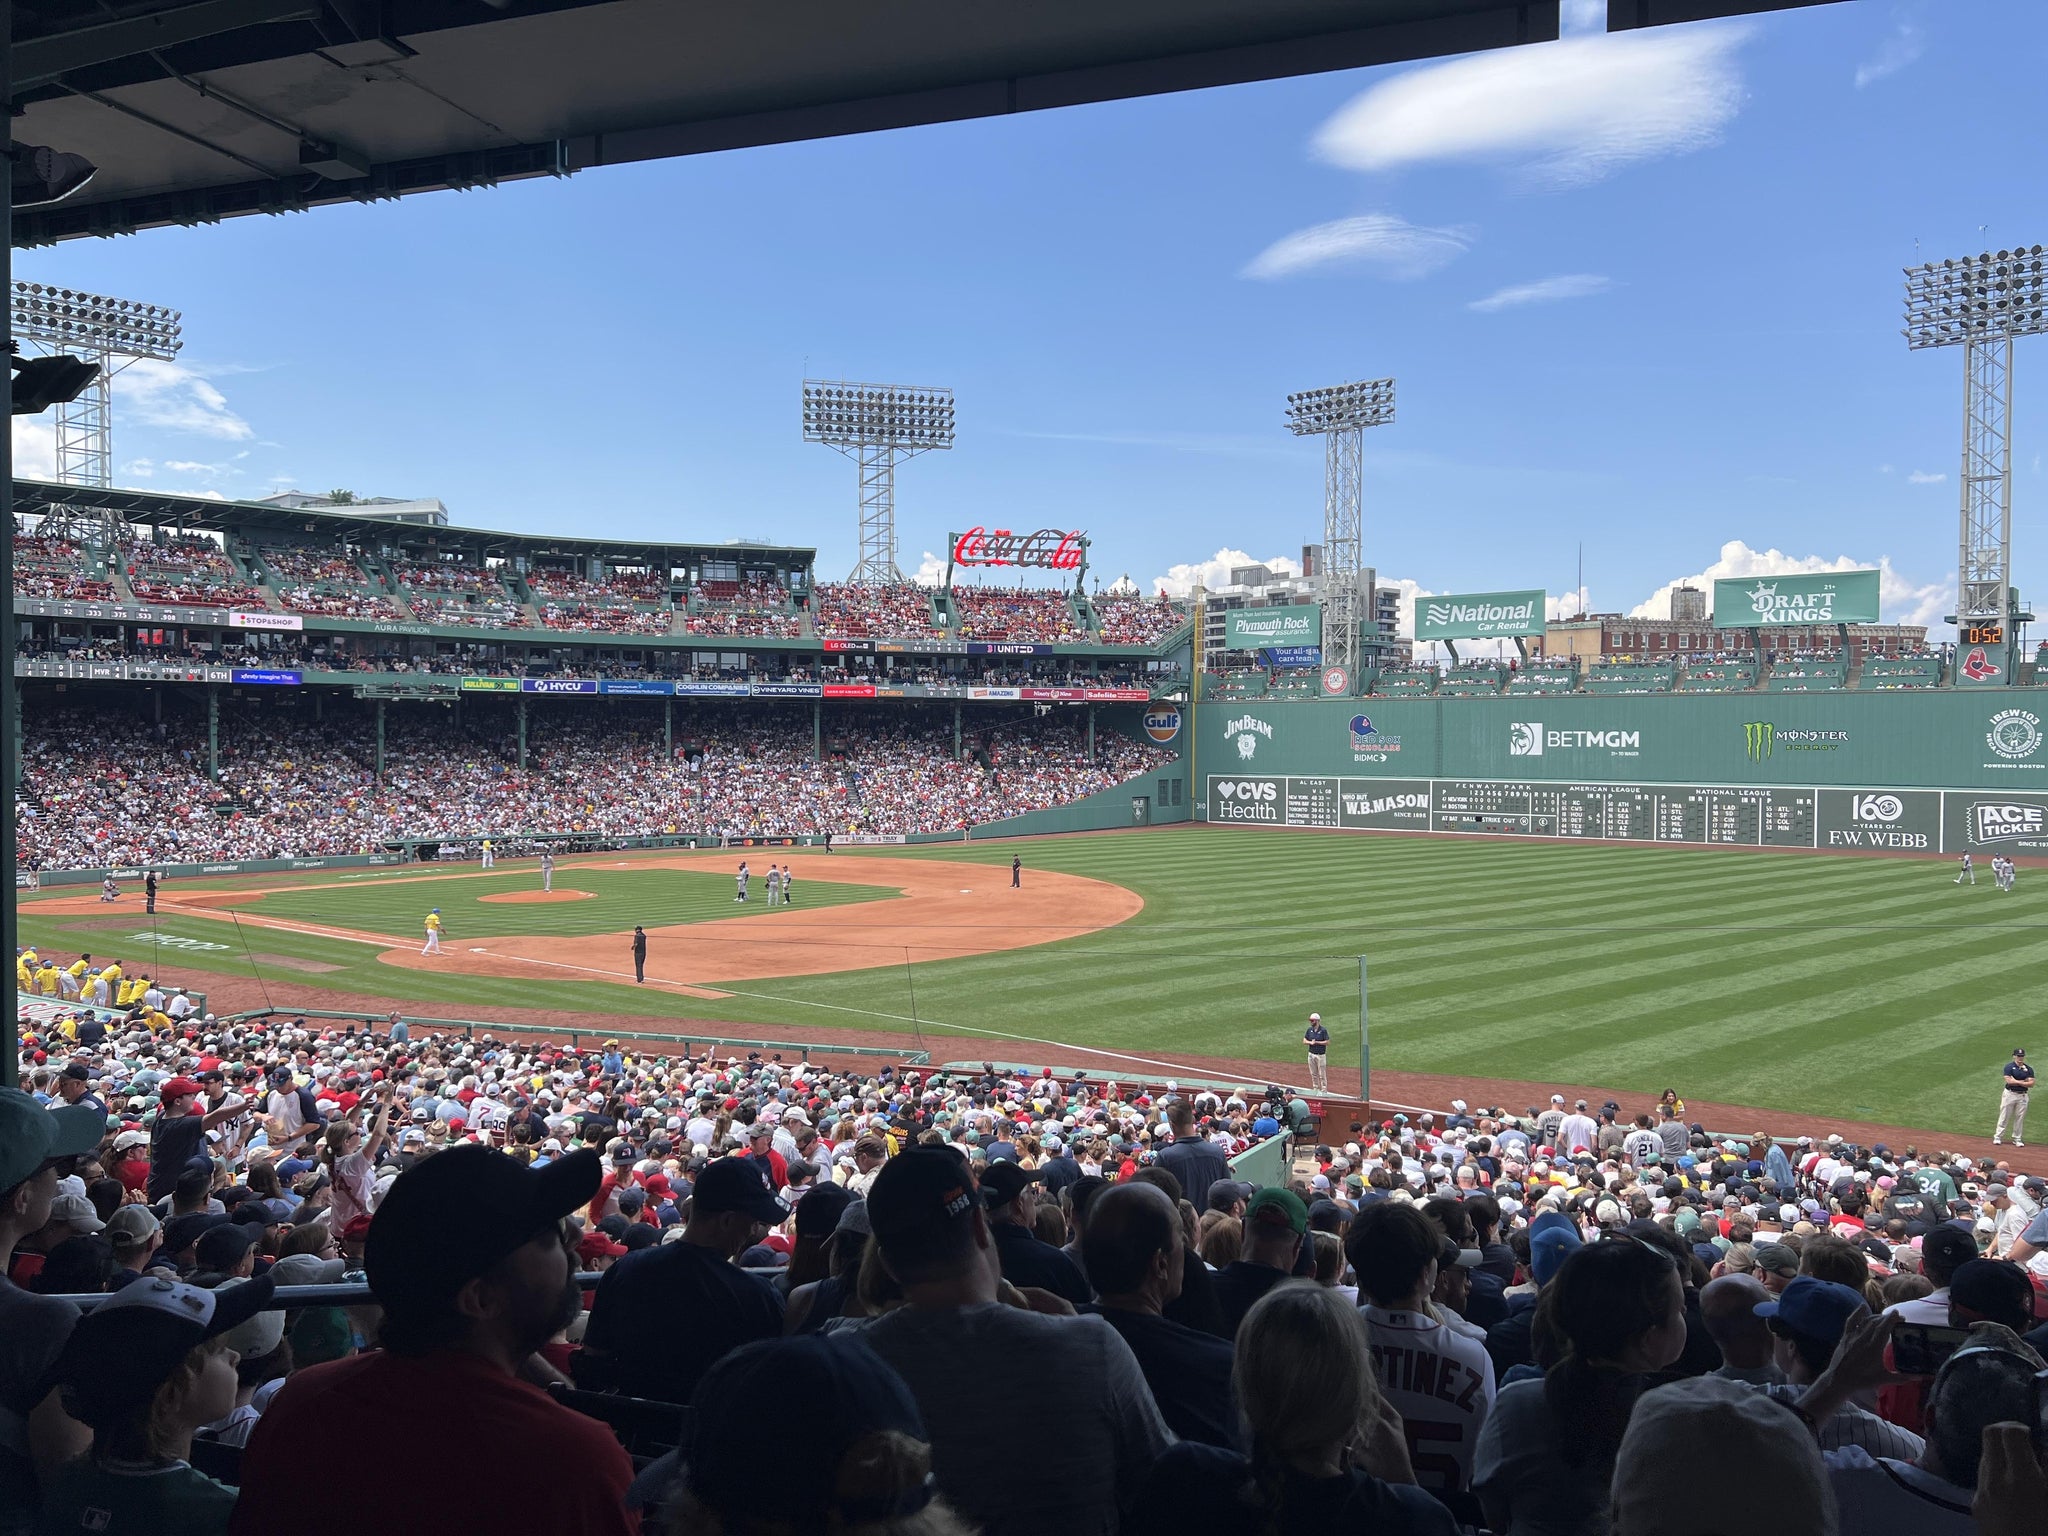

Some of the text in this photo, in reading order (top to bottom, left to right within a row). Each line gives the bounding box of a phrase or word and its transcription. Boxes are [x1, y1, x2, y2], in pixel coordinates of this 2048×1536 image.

[954, 527, 1088, 570] Coca-Cola
[1450, 600, 1532, 622] National
[1752, 593, 1836, 613] DRAFT
[246, 617, 293, 625] STOP&SHOP
[1761, 607, 1833, 623] KINGS
[399, 626, 430, 634] PAVILION
[1236, 616, 1310, 633] Plymouth Rock
[1477, 621, 1528, 630] Car Rental
[1970, 628, 2002, 643] 0:52
[997, 645, 1033, 654] UNITED
[210, 671, 227, 679] 6TH
[464, 681, 495, 689] SULLIVAN
[550, 682, 581, 691] HYCU
[1144, 714, 1178, 728] Gulf
[1989, 709, 2040, 725] IBEW 103
[1224, 715, 1273, 740] JIM BEAM
[1355, 736, 1401, 744] RED SOX
[1548, 731, 1639, 747] BETMGM
[1986, 733, 1997, 751] NECA
[1995, 733, 2043, 759] CONTRACTORS
[1354, 754, 1378, 762] BIDMC
[1237, 782, 1277, 800] CVS
[1220, 800, 1277, 819] Health
[1346, 793, 1429, 815] W.B.MASON
[1853, 795, 1903, 821] 160
[1983, 806, 2043, 824] ACE
[1984, 823, 2043, 835] TICKET
[1829, 830, 1927, 848] F.W. WEBB
[203, 864, 238, 872] smartwater
[480, 1106, 491, 1119] 7
[1639, 1144, 1653, 1157] 21
[1919, 1177, 1940, 1196] 34
[946, 1193, 970, 1217] 1958
